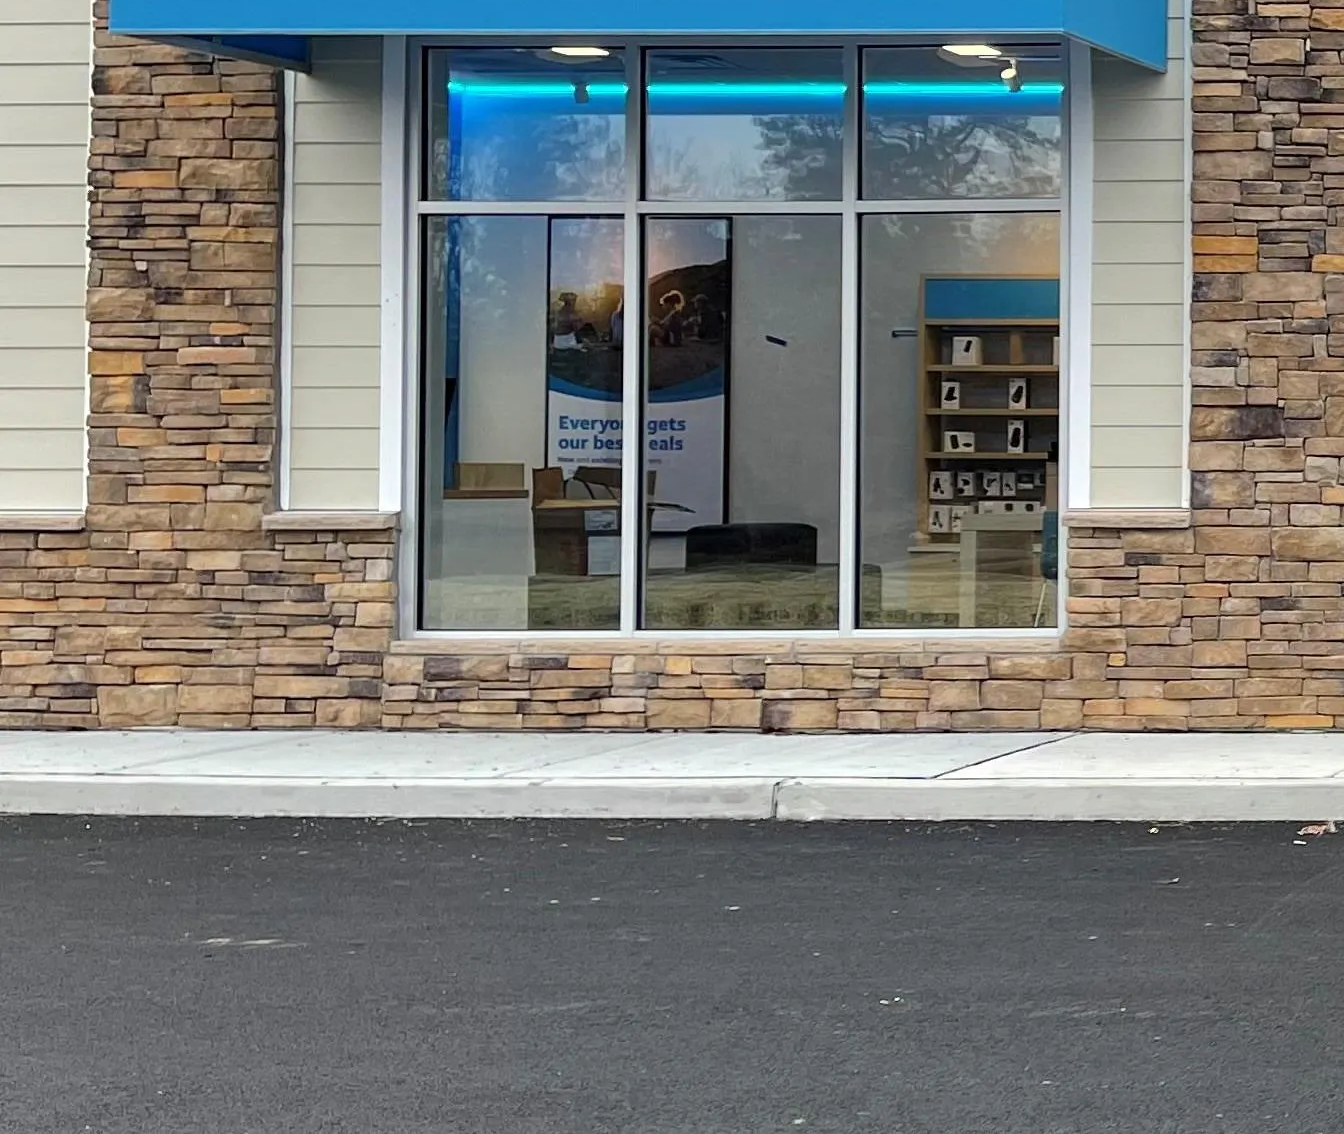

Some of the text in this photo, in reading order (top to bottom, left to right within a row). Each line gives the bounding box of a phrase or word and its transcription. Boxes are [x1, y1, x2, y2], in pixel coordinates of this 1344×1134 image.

[559, 416, 686, 434] Everyo gets
[558, 435, 683, 450] our bes eals
